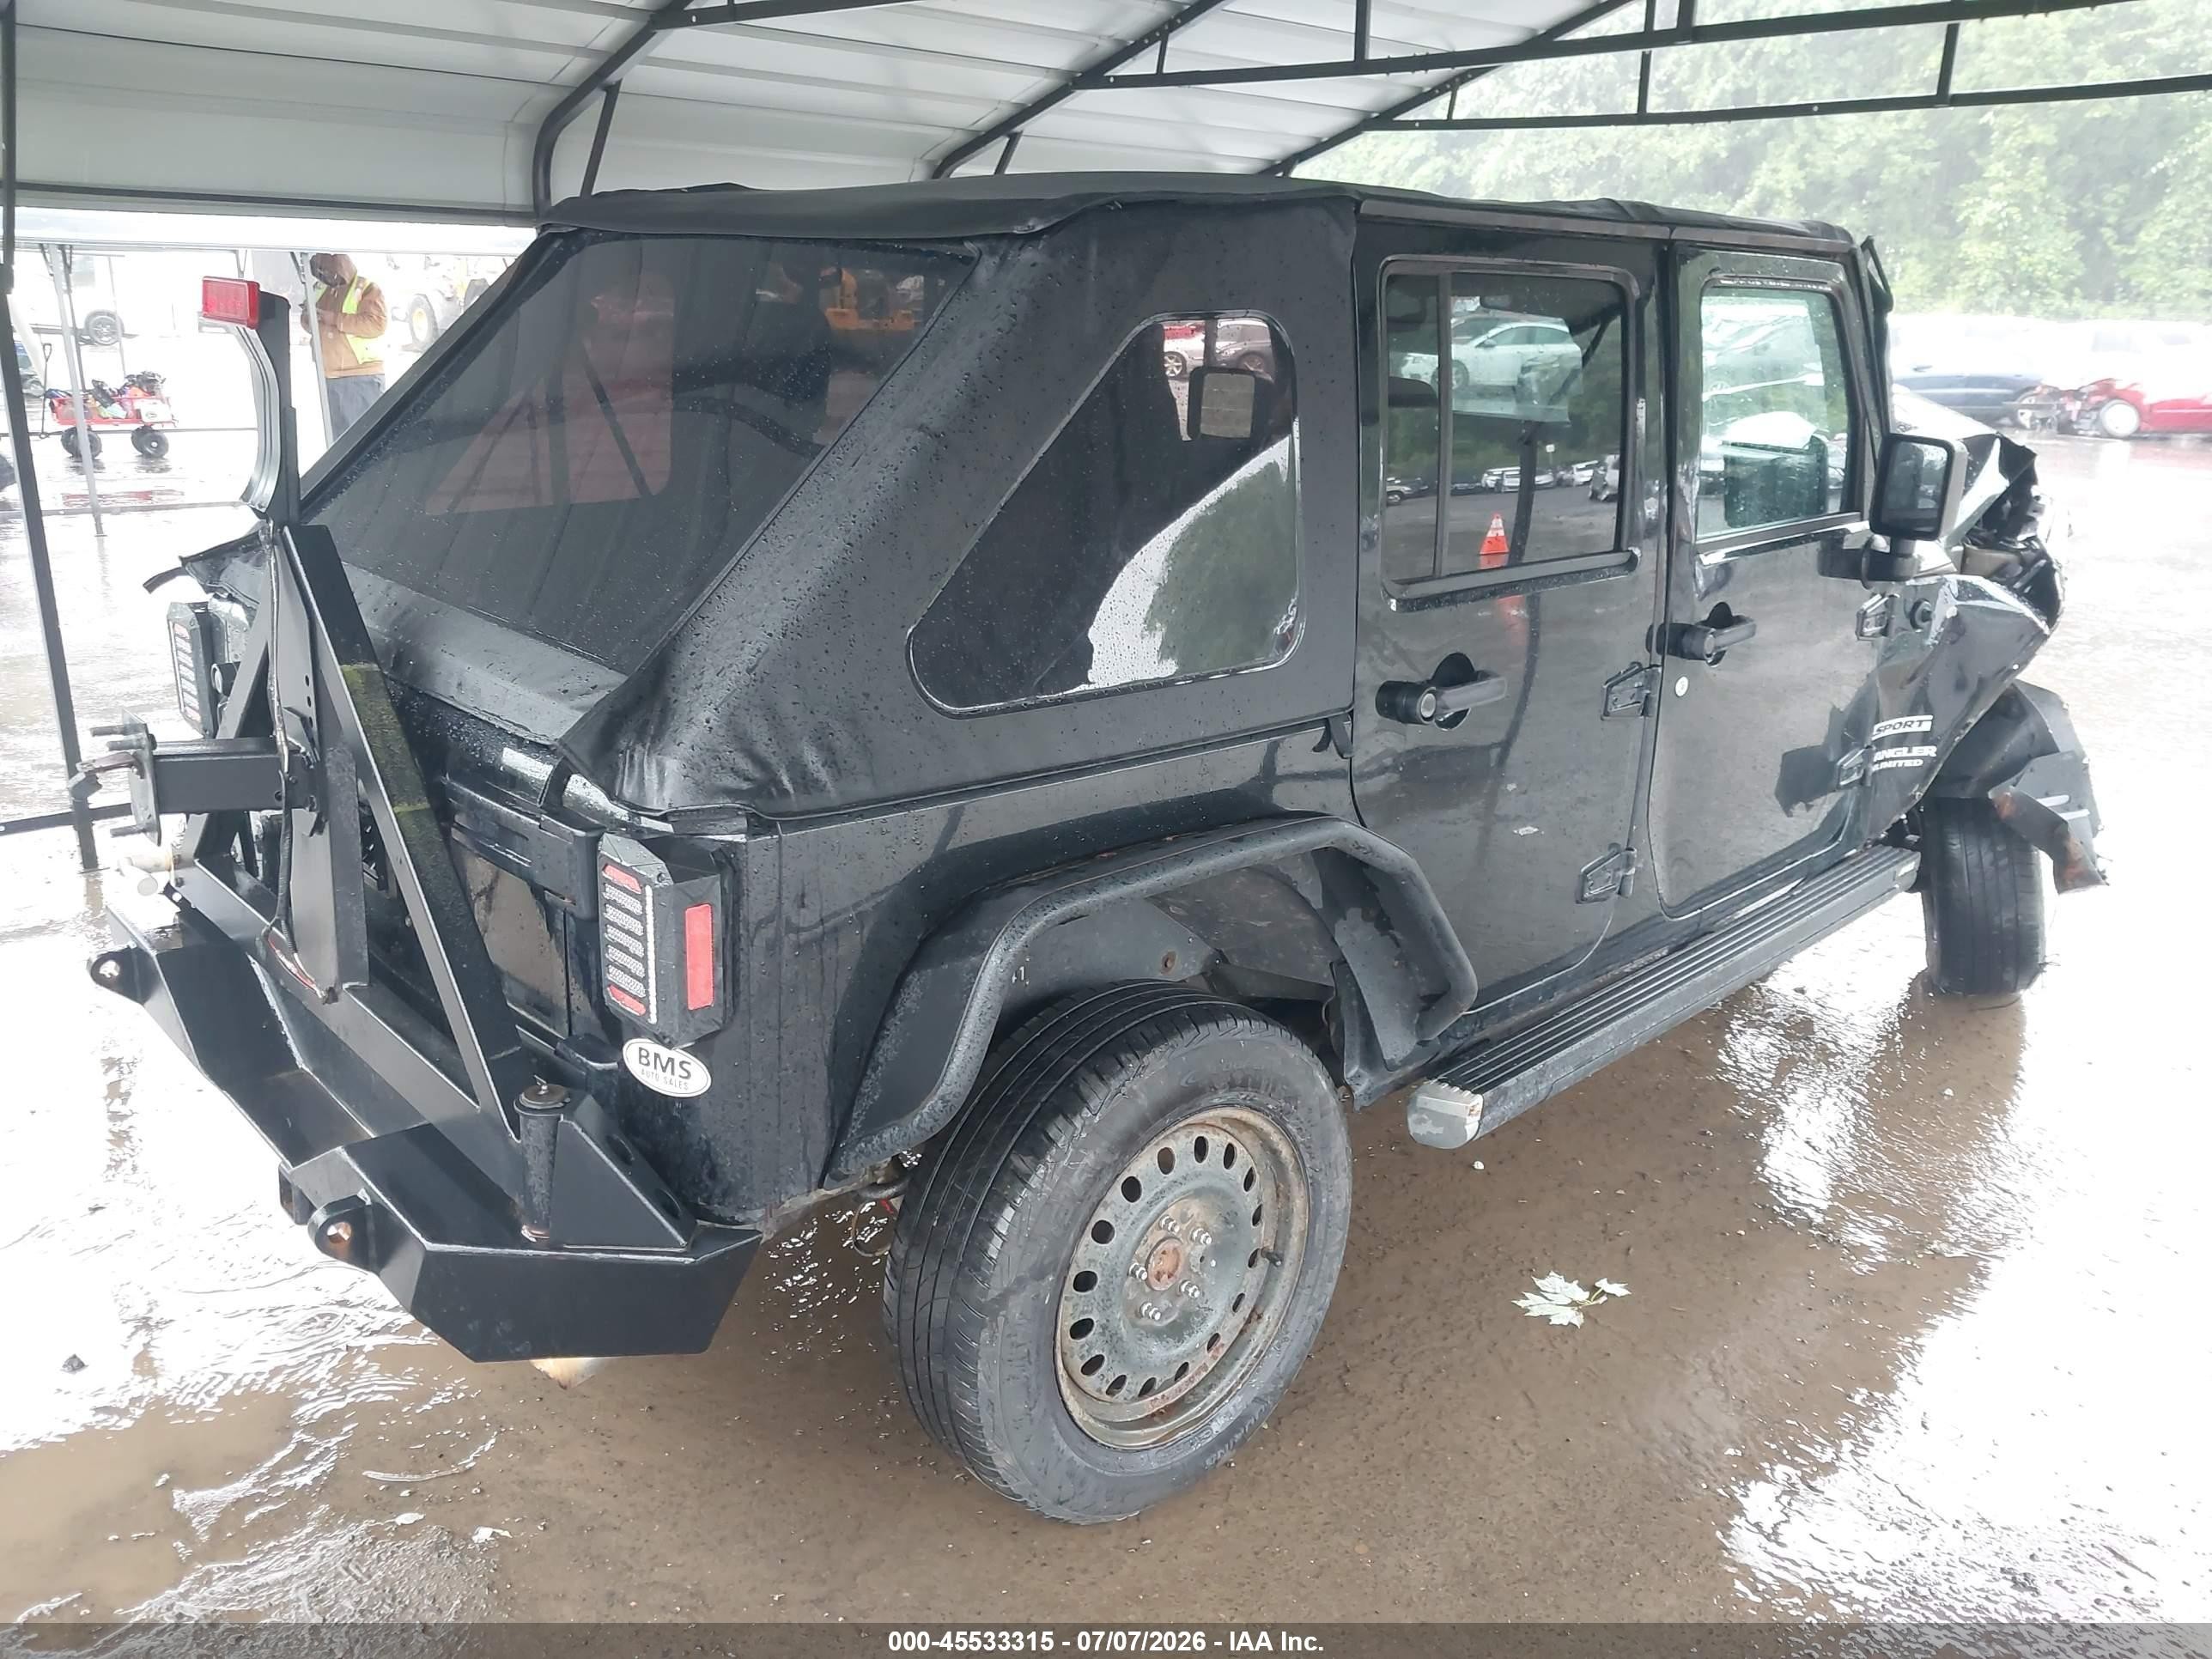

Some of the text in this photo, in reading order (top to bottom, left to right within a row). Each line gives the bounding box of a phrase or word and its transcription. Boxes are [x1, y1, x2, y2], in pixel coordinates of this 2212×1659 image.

[1875, 720, 1924, 732] SPORT
[638, 1047, 691, 1079] BMS
[641, 1068, 689, 1091] AUTO SALES
